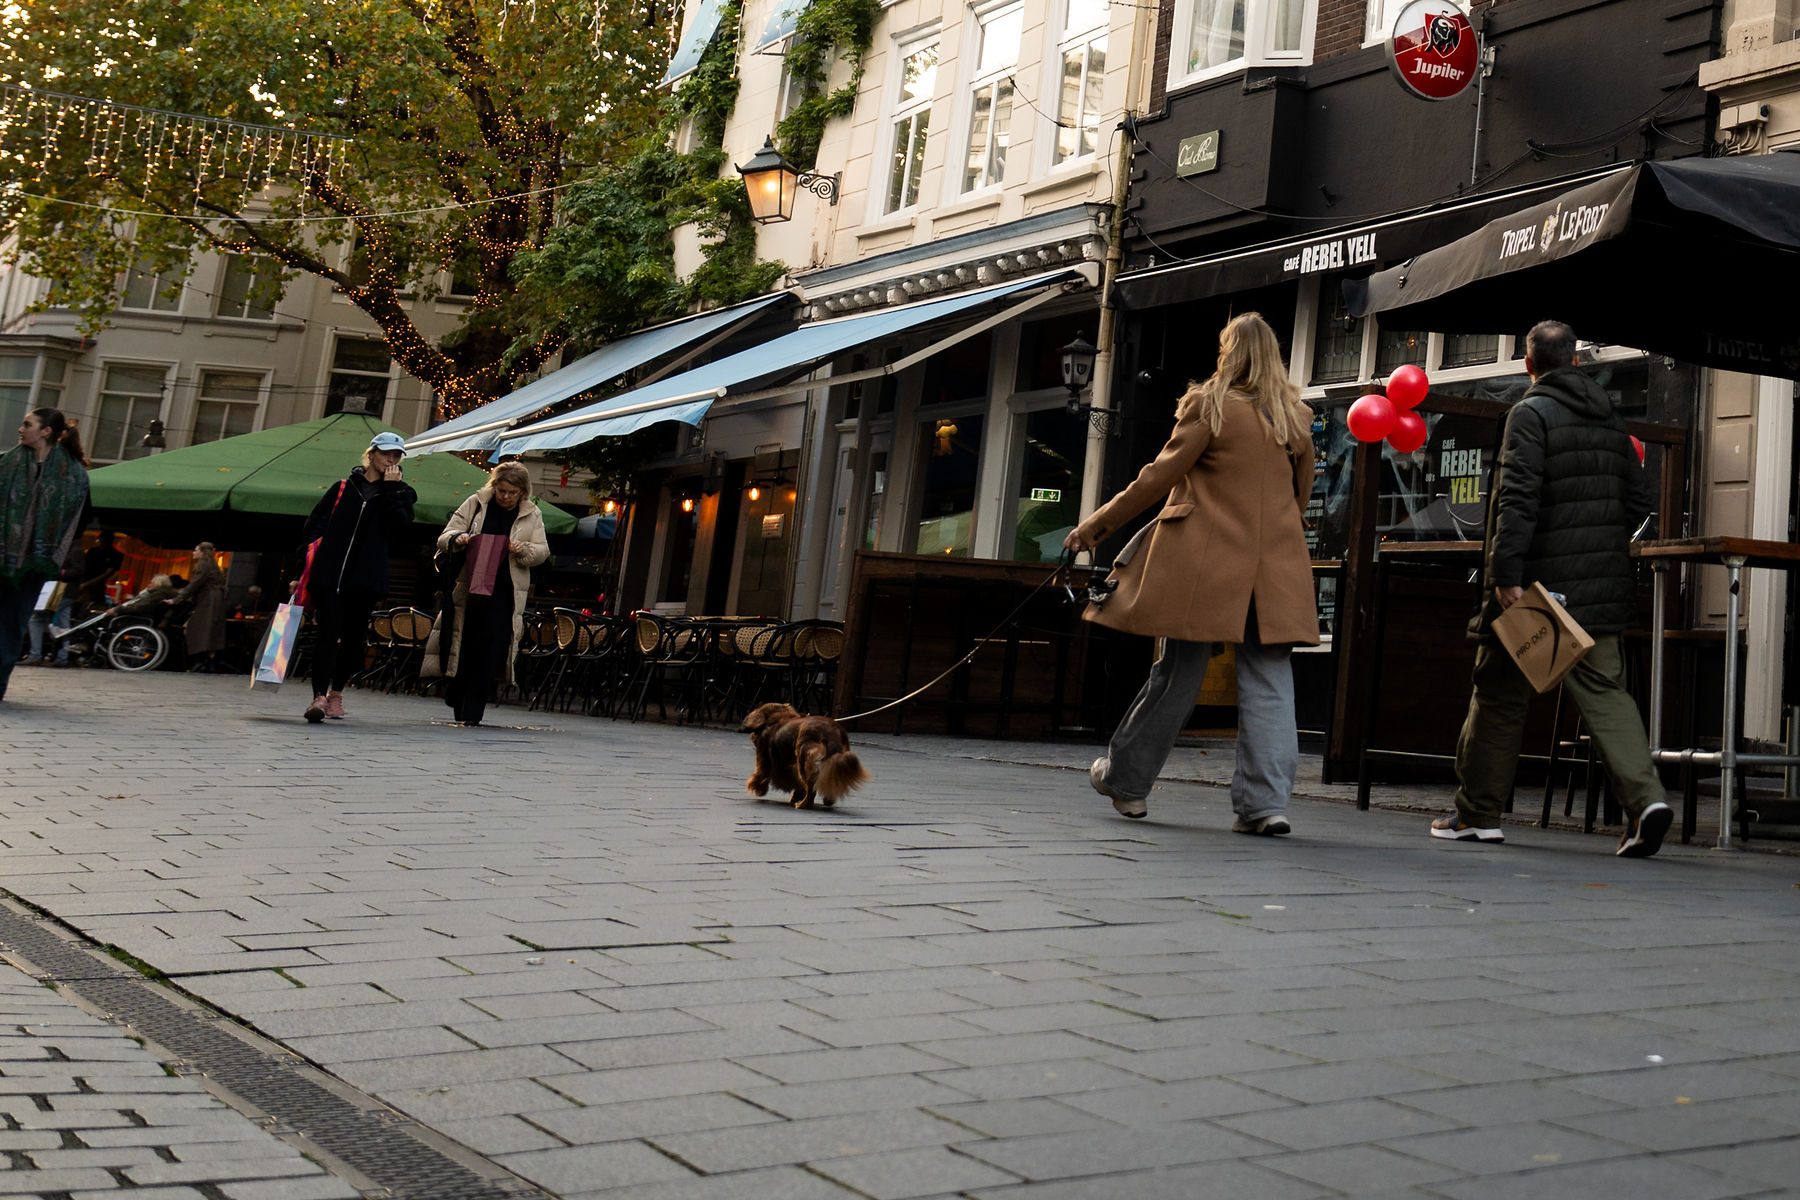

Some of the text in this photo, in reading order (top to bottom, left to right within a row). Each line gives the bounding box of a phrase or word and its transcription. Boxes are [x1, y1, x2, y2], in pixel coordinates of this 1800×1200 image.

[1409, 57, 1465, 81] Jupiler
[1283, 232, 1377, 274] CAFÉ REBEL YELL
[1499, 224, 1537, 260] TRIPEL
[1440, 448, 1482, 478] REBEL
[1450, 476, 1480, 504] YELL
[1515, 626, 1548, 659] PRO DUO
